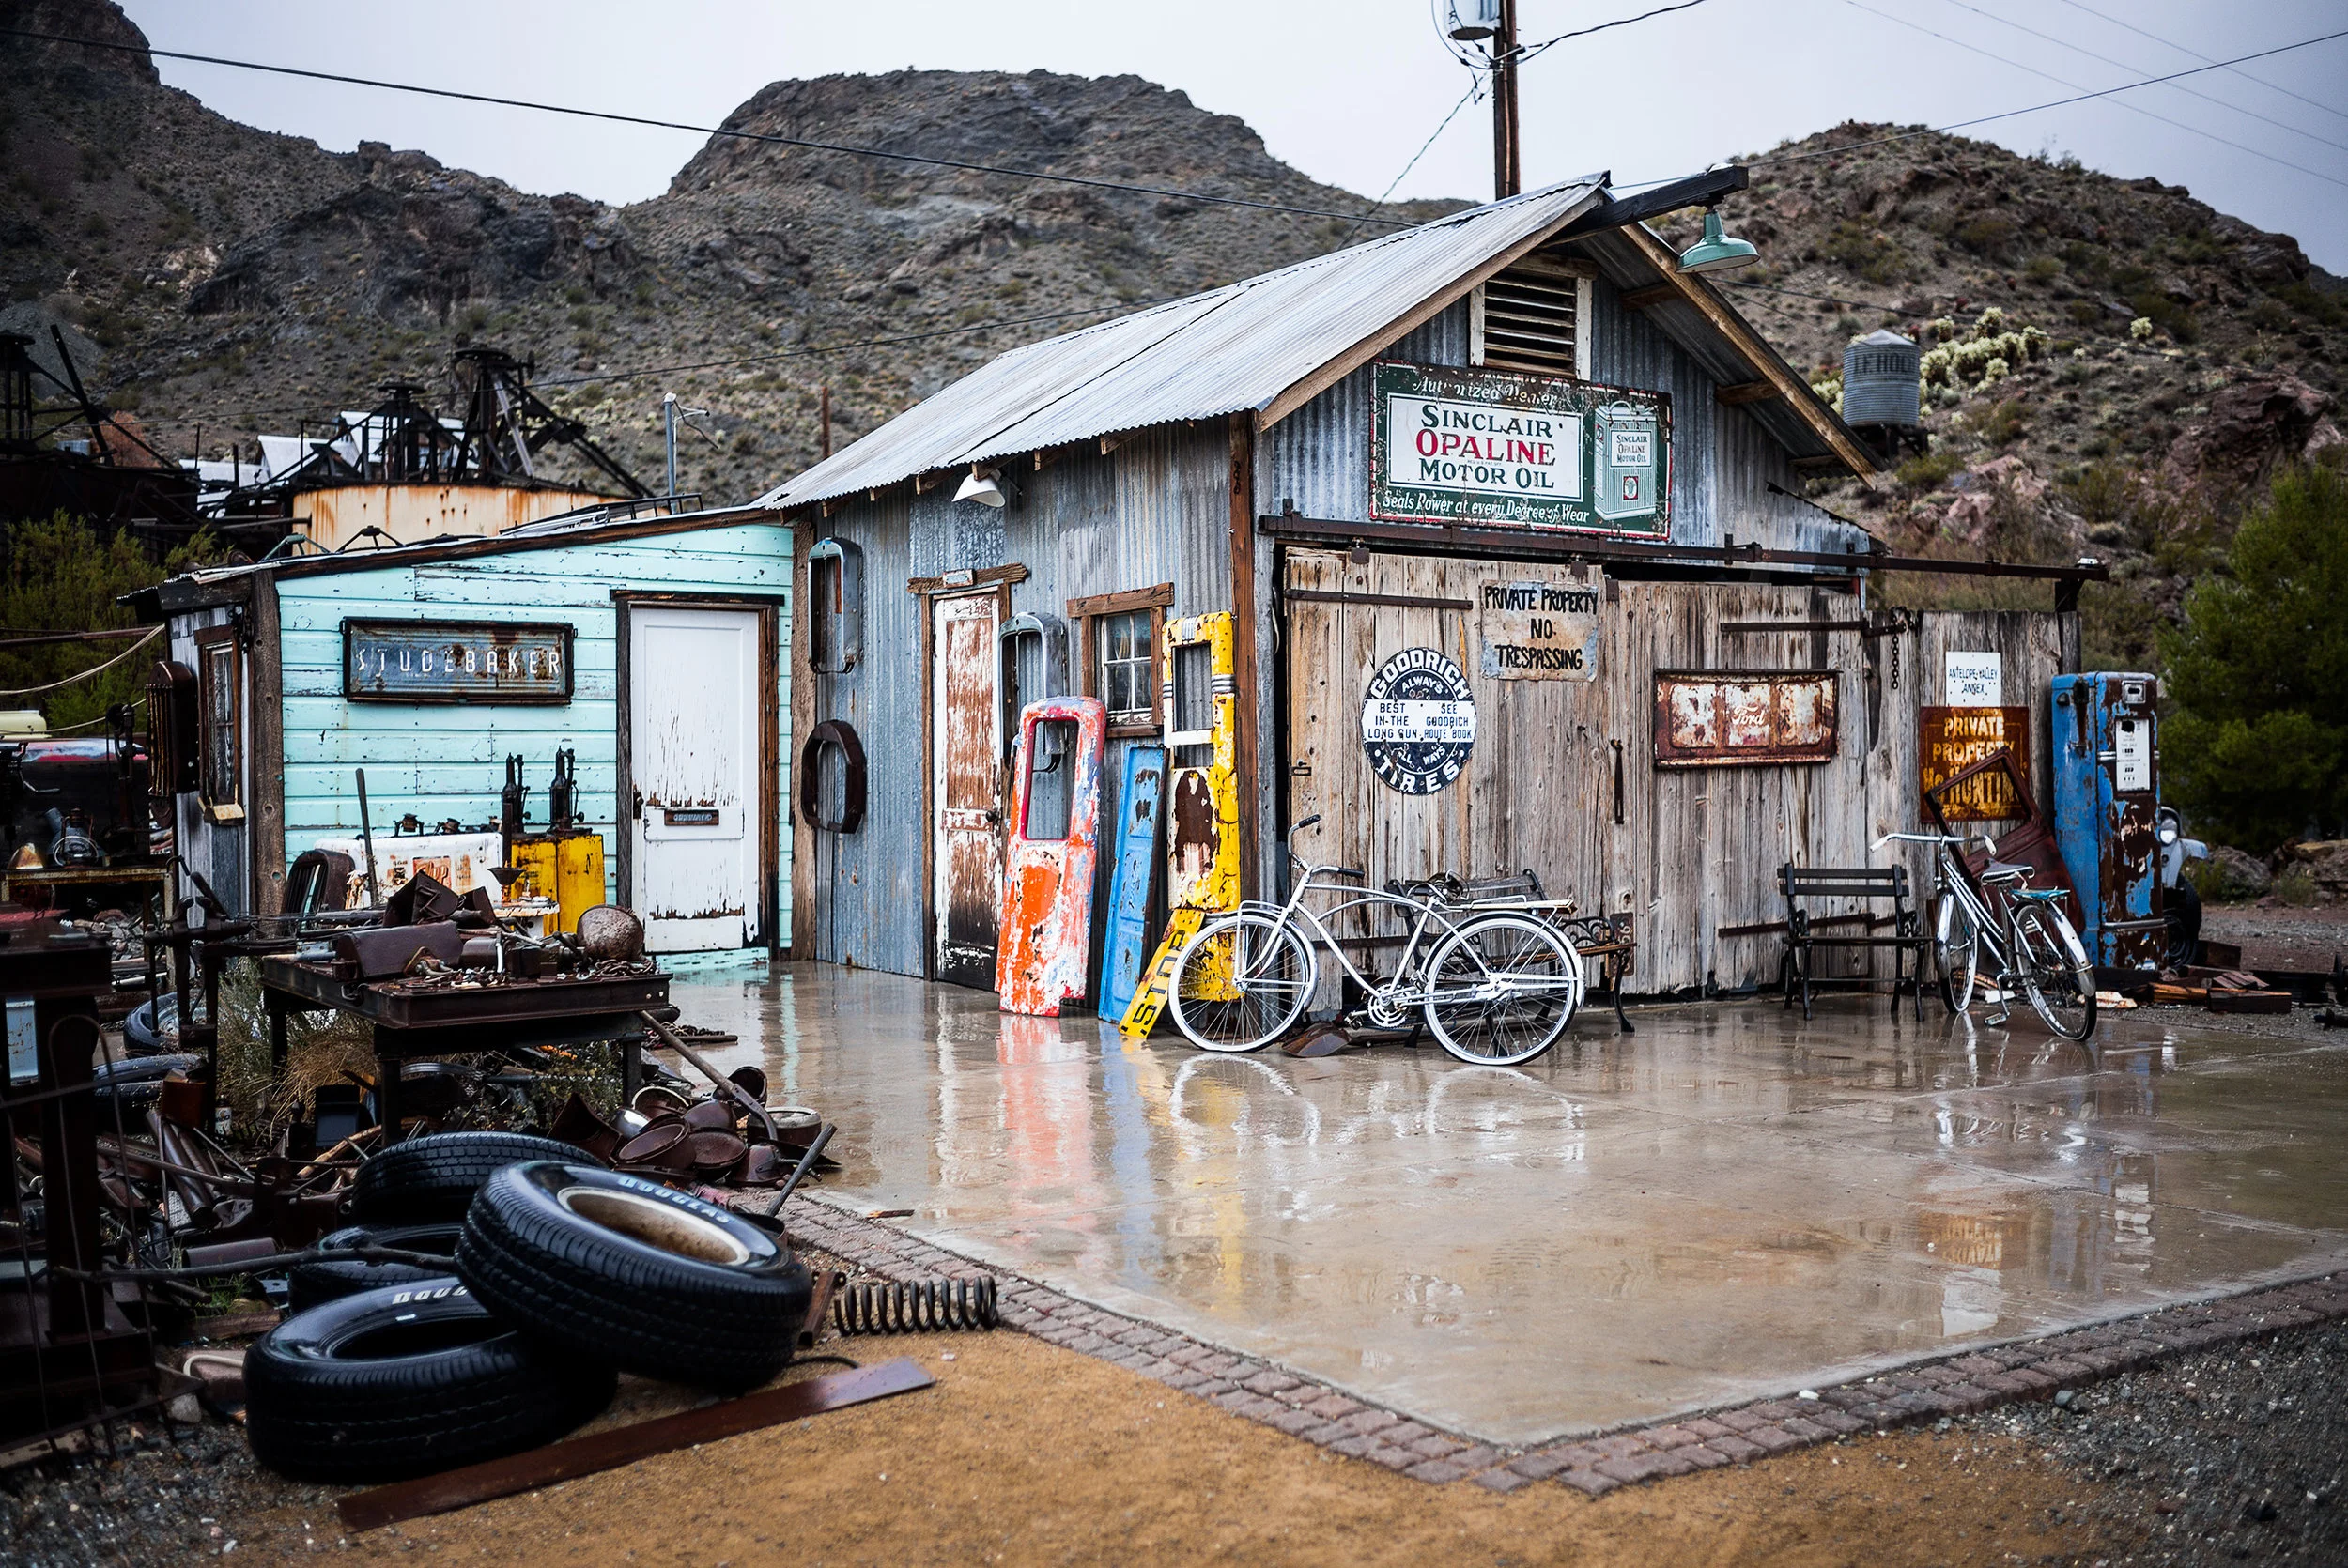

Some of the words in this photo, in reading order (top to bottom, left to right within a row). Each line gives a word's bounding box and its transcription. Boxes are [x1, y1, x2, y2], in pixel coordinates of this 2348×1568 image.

[1421, 405, 1553, 438] SINCLAIR
[1416, 428, 1555, 466] OPALINE
[1616, 434, 1647, 443] SINCLAIR
[1618, 443, 1645, 453] OPALINE
[1616, 453, 1635, 463] MOTOR
[1637, 453, 1646, 463] OIL
[1419, 458, 1507, 484] MOTOR
[1515, 467, 1554, 489] OIL
[1383, 490, 1414, 509] Seals
[1415, 492, 1454, 513] Power
[1455, 499, 1468, 514] at
[1472, 501, 1505, 519] every
[1506, 500, 1546, 520] Degree
[1561, 503, 1590, 523] Wear
[1484, 586, 1537, 611] PRIVATE
[1540, 588, 1598, 615] PROPERTY
[1530, 618, 1553, 639] NO
[358, 648, 560, 675] STUDEBAKER
[1494, 644, 1583, 670] TRESPASSING
[1369, 649, 1474, 699] GOODRICH
[1401, 675, 1444, 694] ALWAYS
[1380, 702, 1406, 713] BEST
[1441, 703, 1458, 714] SEE
[1732, 705, 1765, 726] Ford
[1426, 716, 1469, 727] GOODRICH
[1944, 716, 2005, 737] PRIVATE
[1367, 728, 1394, 739] LONG
[1424, 729, 1447, 739] ROUTE
[1452, 729, 1472, 739] BOOK
[1422, 745, 1446, 765] WAYS
[1378, 754, 1460, 792] TIRES
[1133, 930, 1186, 1025] STOP
